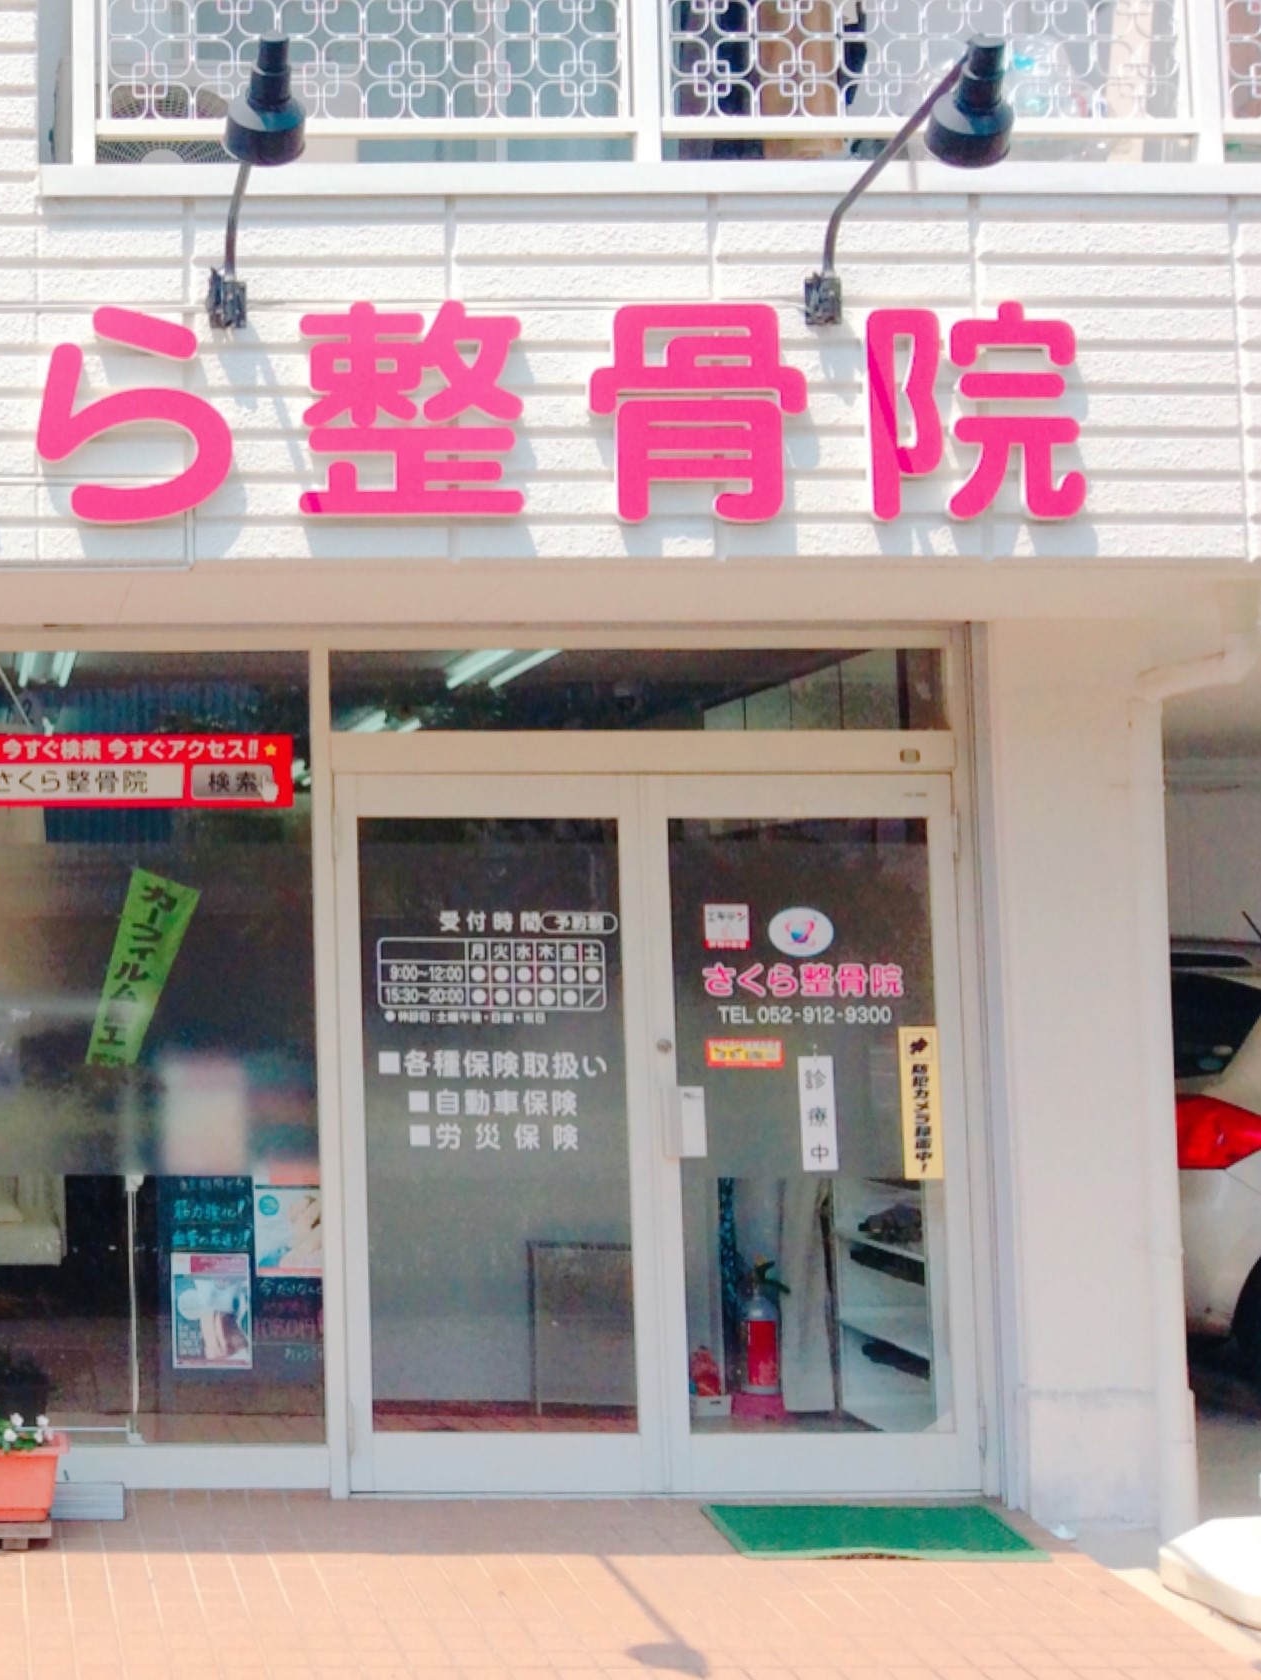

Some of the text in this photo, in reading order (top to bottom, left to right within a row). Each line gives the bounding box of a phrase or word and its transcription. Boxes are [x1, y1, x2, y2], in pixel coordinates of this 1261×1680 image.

[207, 770, 262, 796] 検索
[439, 911, 541, 933] 受付時間
[471, 944, 600, 961] 月 火 水 木 金 土
[702, 961, 905, 998] さくら整骨院
[717, 1005, 892, 1024] TEL 052-912-9300
[404, 1050, 608, 1079] 各種保険取扱い
[435, 1089, 579, 1117] 自動車保険
[804, 1069, 830, 1164] 診療中
[435, 1123, 579, 1152] 労災保険
